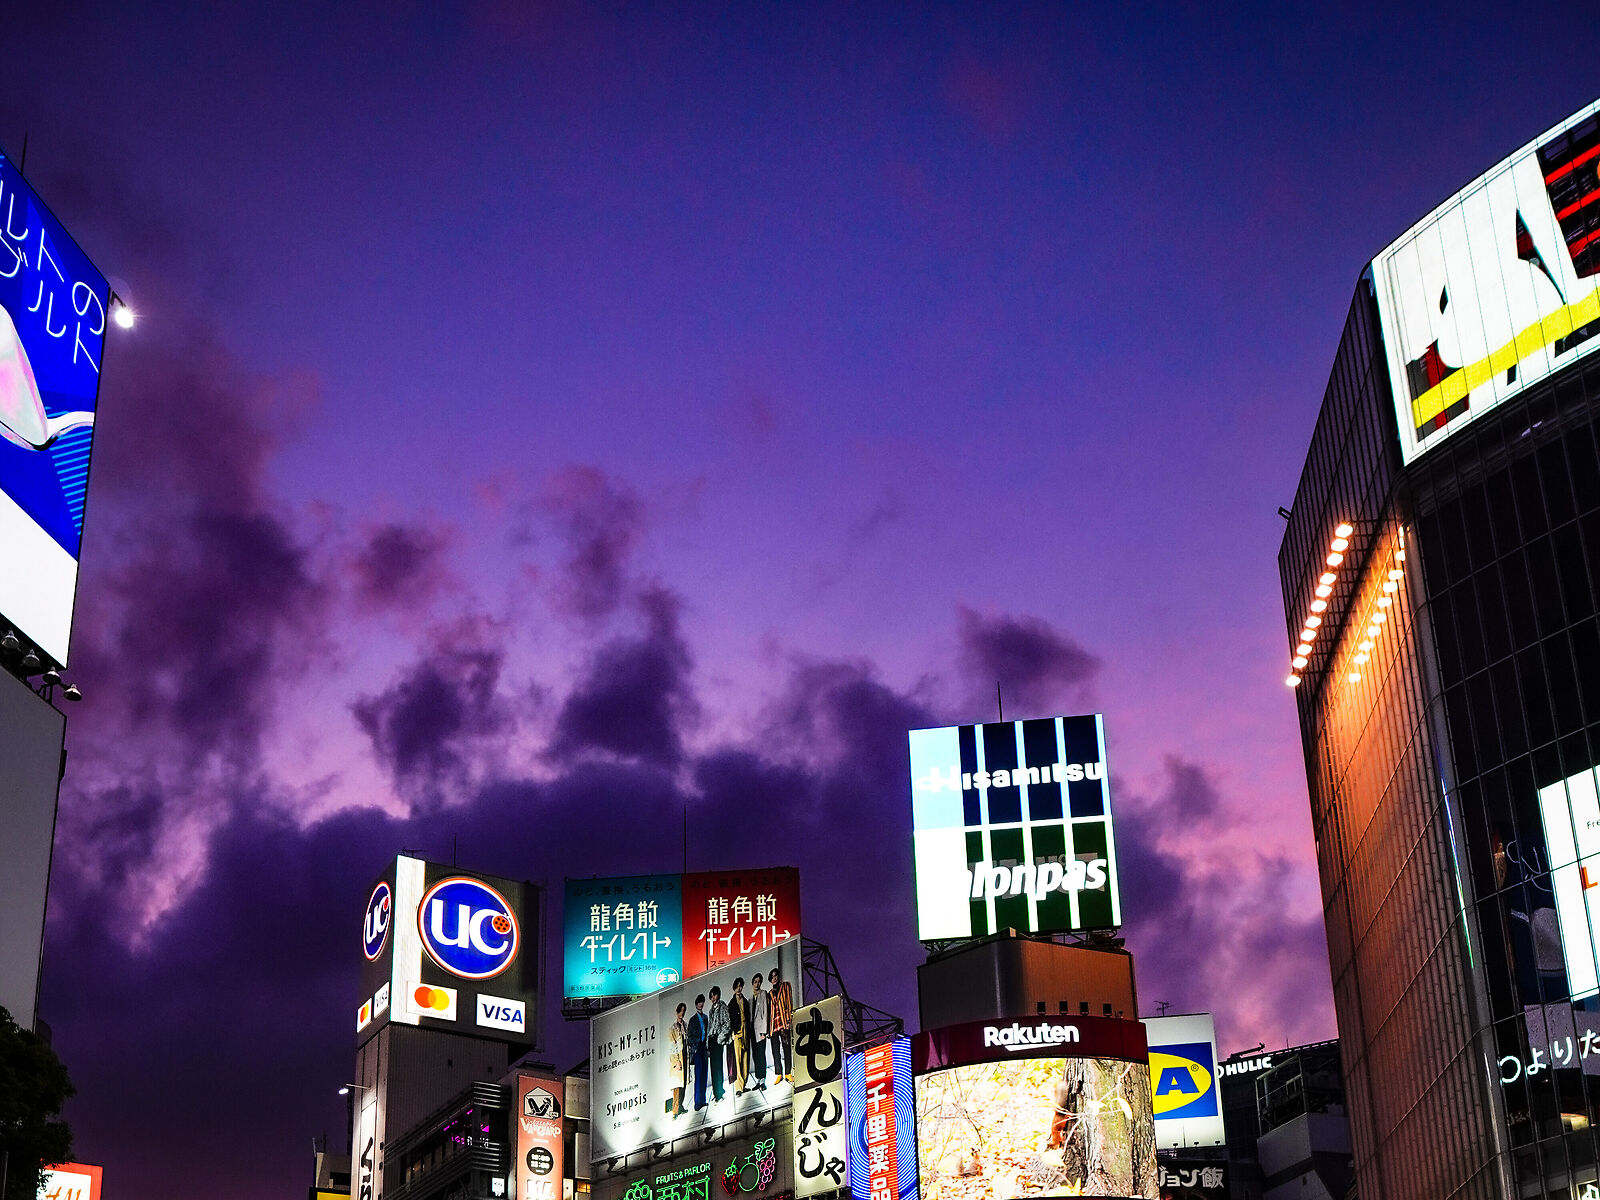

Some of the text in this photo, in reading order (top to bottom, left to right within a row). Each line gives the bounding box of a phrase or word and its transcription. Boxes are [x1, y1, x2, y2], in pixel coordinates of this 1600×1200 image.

[967, 859, 1106, 900] lonpas
[366, 894, 389, 944] UC
[590, 900, 658, 932] 龍角散
[708, 893, 777, 925] 龍角散
[431, 898, 512, 956] UC
[698, 925, 791, 956] ダイレクト
[580, 932, 672, 963] ダイレクト
[591, 965, 626, 975] スティック
[658, 973, 678, 983] 生薬
[481, 1002, 523, 1024] VISA
[598, 1025, 656, 1060] KIS-MY-FT2
[984, 1022, 1079, 1047] Rakuten
[1226, 1057, 1271, 1076] HULIC
[606, 1092, 647, 1117] Synopsis
[794, 1007, 846, 1182] もんじゃ
